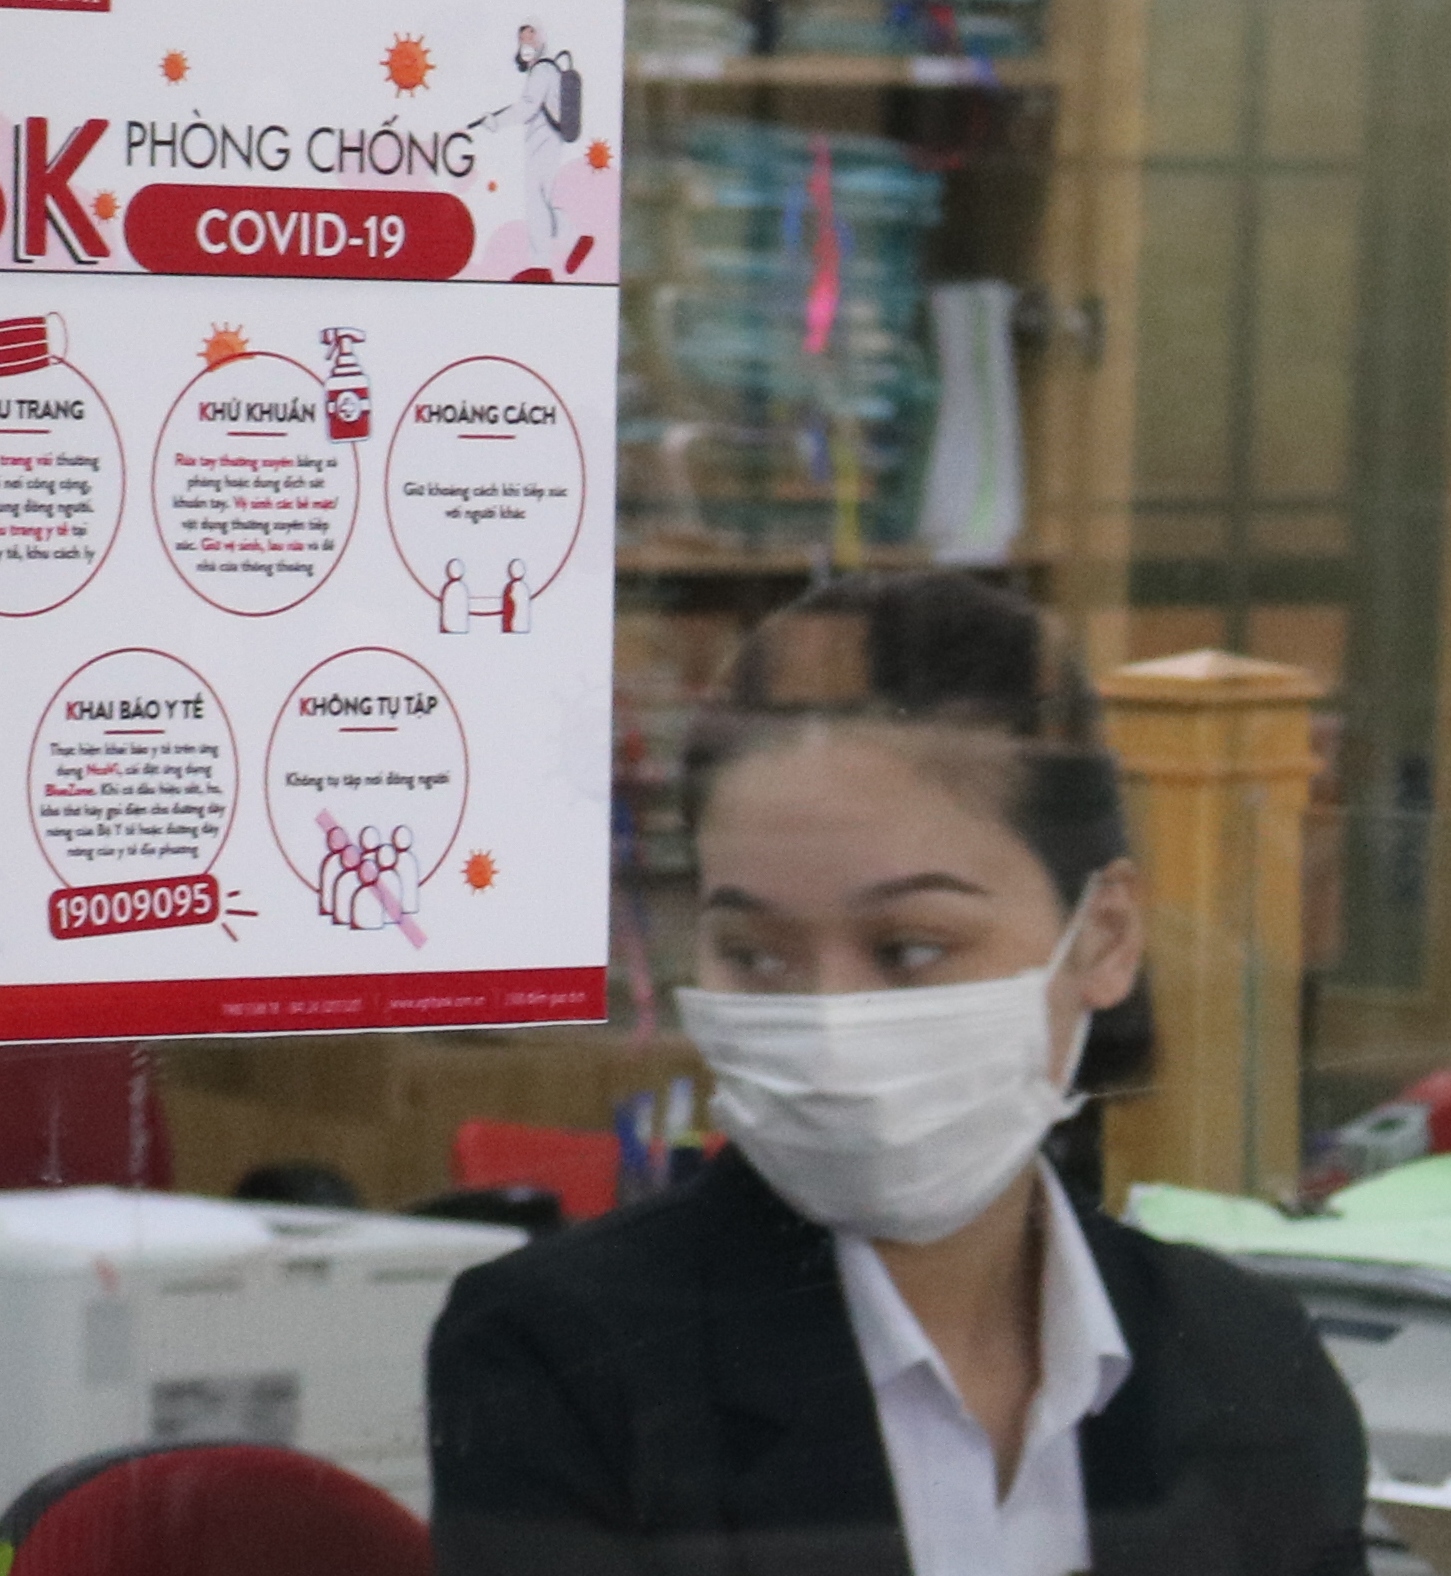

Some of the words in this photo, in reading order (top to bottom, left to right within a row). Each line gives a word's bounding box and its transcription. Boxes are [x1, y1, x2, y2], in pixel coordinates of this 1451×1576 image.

[126, 110, 291, 171] PHÒNG
[307, 115, 475, 178] CHỐNG
[0, 117, 110, 263] K
[196, 208, 405, 259] COVID-19
[15, 400, 85, 419] TRANG
[199, 397, 241, 422] KHỬ
[246, 396, 316, 423] KHUẨN
[414, 399, 499, 424] KHOẢNG
[503, 401, 557, 424] CÁCH
[65, 698, 114, 721] KHAI
[120, 697, 162, 720] BÁO
[164, 699, 178, 720] Y
[183, 691, 205, 719] TẾ
[299, 691, 373, 717] KHÔNG
[378, 696, 400, 720] TỤ
[404, 691, 438, 718] TẬP
[55, 882, 213, 929] 19009095
